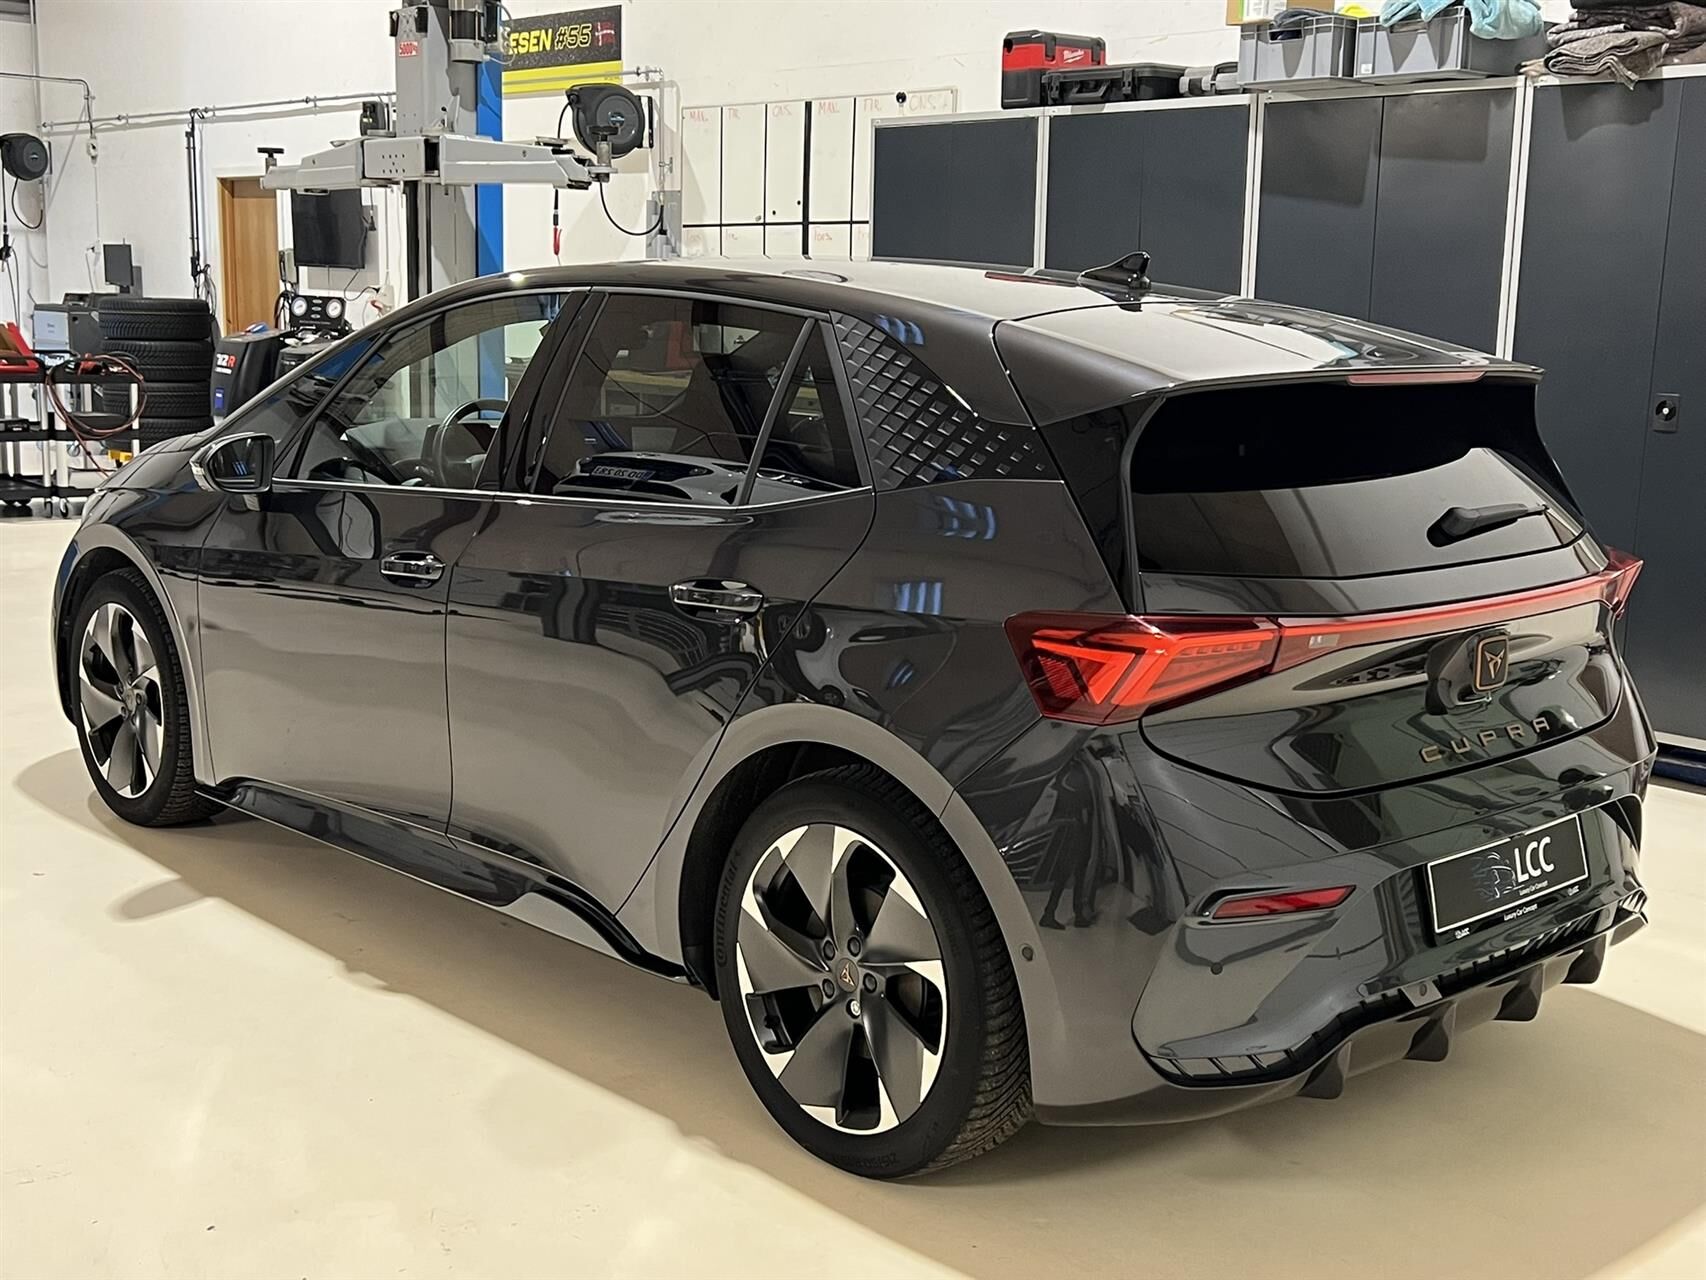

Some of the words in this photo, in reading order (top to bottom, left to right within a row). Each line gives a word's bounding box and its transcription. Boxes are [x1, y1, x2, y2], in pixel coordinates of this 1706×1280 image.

[554, 23, 592, 50] #55
[1419, 717, 1550, 764] CUPRA
[1514, 836, 1555, 882] LCC
